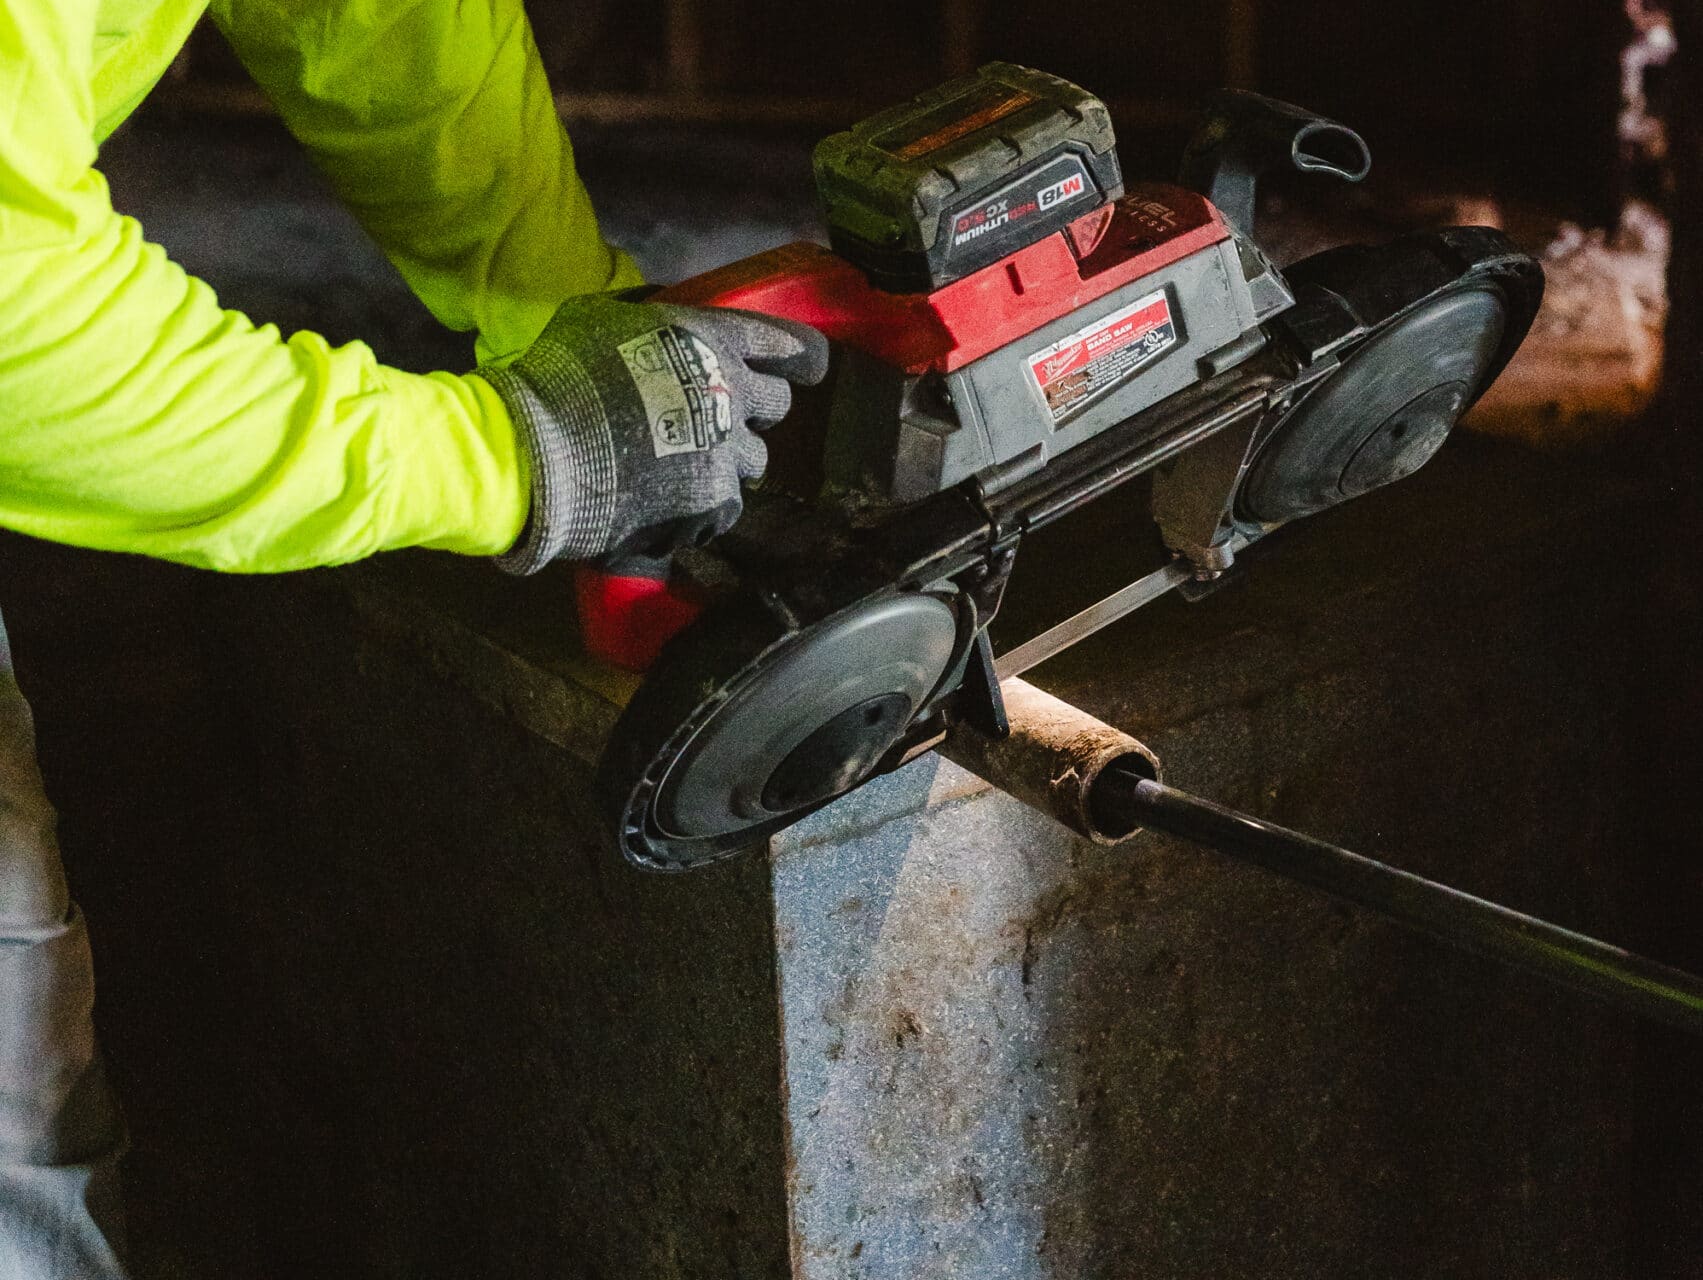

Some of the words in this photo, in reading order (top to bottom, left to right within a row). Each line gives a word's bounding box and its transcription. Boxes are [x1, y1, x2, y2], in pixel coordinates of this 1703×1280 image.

[1042, 177, 1082, 206] M18
[986, 200, 1009, 218] XC
[1087, 332, 1112, 351] BAND
[1113, 322, 1133, 337] SAW
